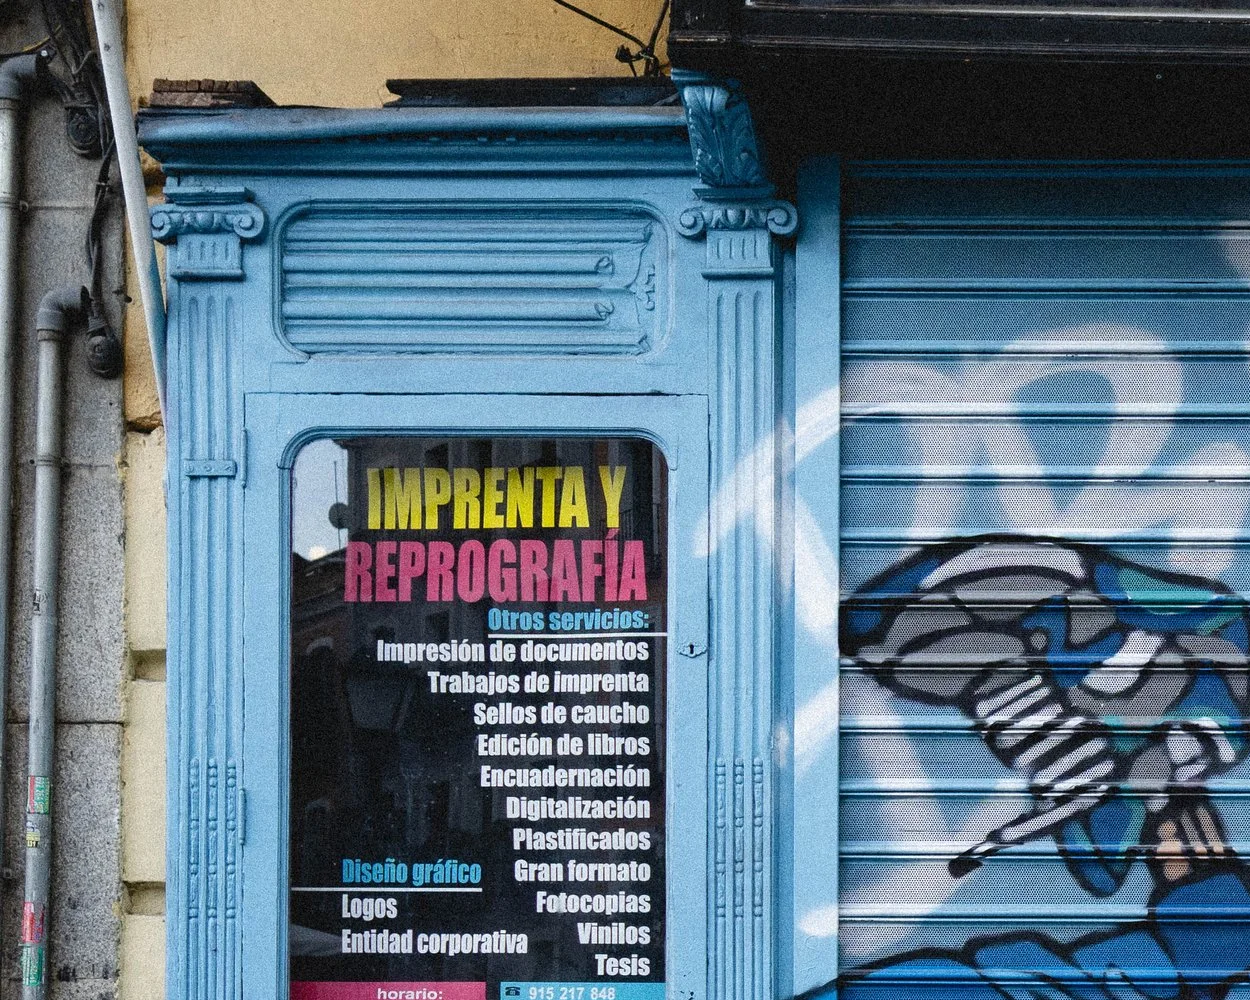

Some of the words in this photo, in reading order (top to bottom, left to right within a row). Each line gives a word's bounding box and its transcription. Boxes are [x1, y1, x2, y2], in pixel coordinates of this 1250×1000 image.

[366, 466, 590, 530] IMPRENTA
[599, 465, 627, 529] Y
[344, 529, 648, 602] REPROGRAFÍA
[488, 608, 545, 631] Otros
[548, 608, 650, 630] servicios:
[377, 638, 485, 664] Impresión
[489, 640, 516, 662] de
[520, 640, 650, 662] documentos
[427, 671, 520, 696] Trabajos
[524, 672, 549, 694] de
[553, 671, 650, 695] imprenta
[473, 702, 537, 725] Sellos
[541, 702, 567, 724] de
[571, 702, 650, 725] caucho
[477, 733, 552, 756] Edición
[557, 734, 584, 756] de
[587, 733, 651, 756] libros
[480, 764, 651, 788] Encuadernación
[506, 796, 651, 823] Digitalización
[512, 828, 651, 851] Plastificados
[342, 858, 408, 884] Diseño
[412, 858, 482, 887] gráfico
[514, 860, 564, 883] Gran
[567, 860, 651, 883] formato
[341, 893, 398, 921] Logos
[536, 891, 651, 914] Fotocopias
[341, 929, 413, 954] Entidad
[417, 930, 528, 957] corporativa
[577, 922, 651, 945] Vinilos
[595, 954, 651, 977] Tesis
[377, 988, 443, 1000] horario:
[528, 986, 554, 1000] 915
[559, 986, 585, 1000] 217
[590, 987, 616, 1000] 848
